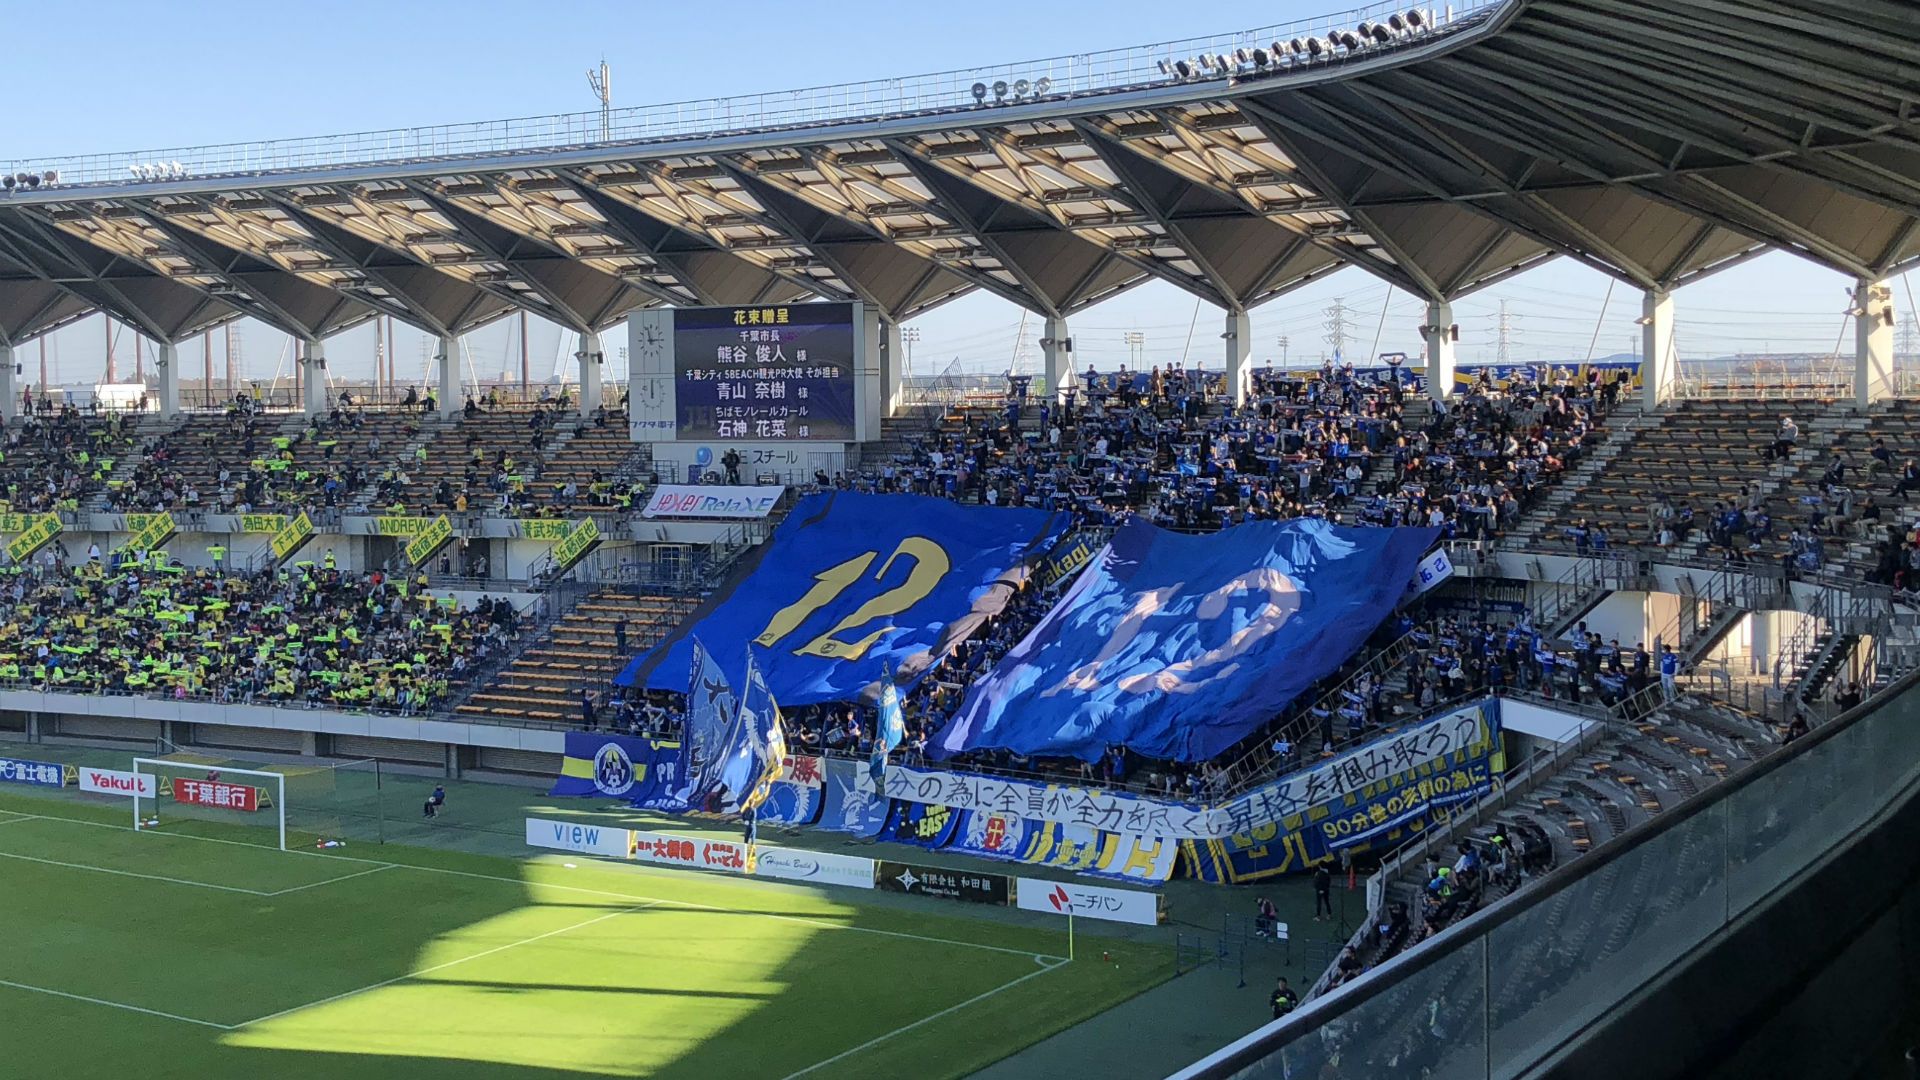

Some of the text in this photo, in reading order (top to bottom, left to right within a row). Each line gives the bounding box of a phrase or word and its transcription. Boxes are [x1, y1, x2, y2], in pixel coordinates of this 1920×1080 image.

[733, 308, 789, 325] 花束贈呈
[739, 330, 780, 343] 千葉市長
[717, 344, 807, 364] 熊谷 俊人 様
[686, 368, 722, 381] 千葉シティ
[806, 366, 839, 378] そが担当
[716, 381, 809, 400] 青山 奈樹 様
[715, 406, 809, 418] ちばモノレールガール
[630, 420, 676, 430] フクダ電子
[717, 419, 809, 438] 石神 花菜 様
[752, 449, 798, 465] スチール
[1, 512, 46, 531] 乾貴
[555, 520, 599, 564] 近藤直也
[1034, 543, 1090, 585] akagi
[751, 536, 951, 662] 12
[16, 763, 59, 785] 富士電機
[90, 772, 147, 793] Yakult
[184, 780, 247, 807] 千葉銀行
[1322, 764, 1487, 839] 90分後の笑顔の為に
[919, 811, 951, 838] EAST
[702, 842, 744, 868] くいどん
[920, 872, 992, 891] 有限会社 和田組
[1073, 893, 1123, 912] ニチバン
